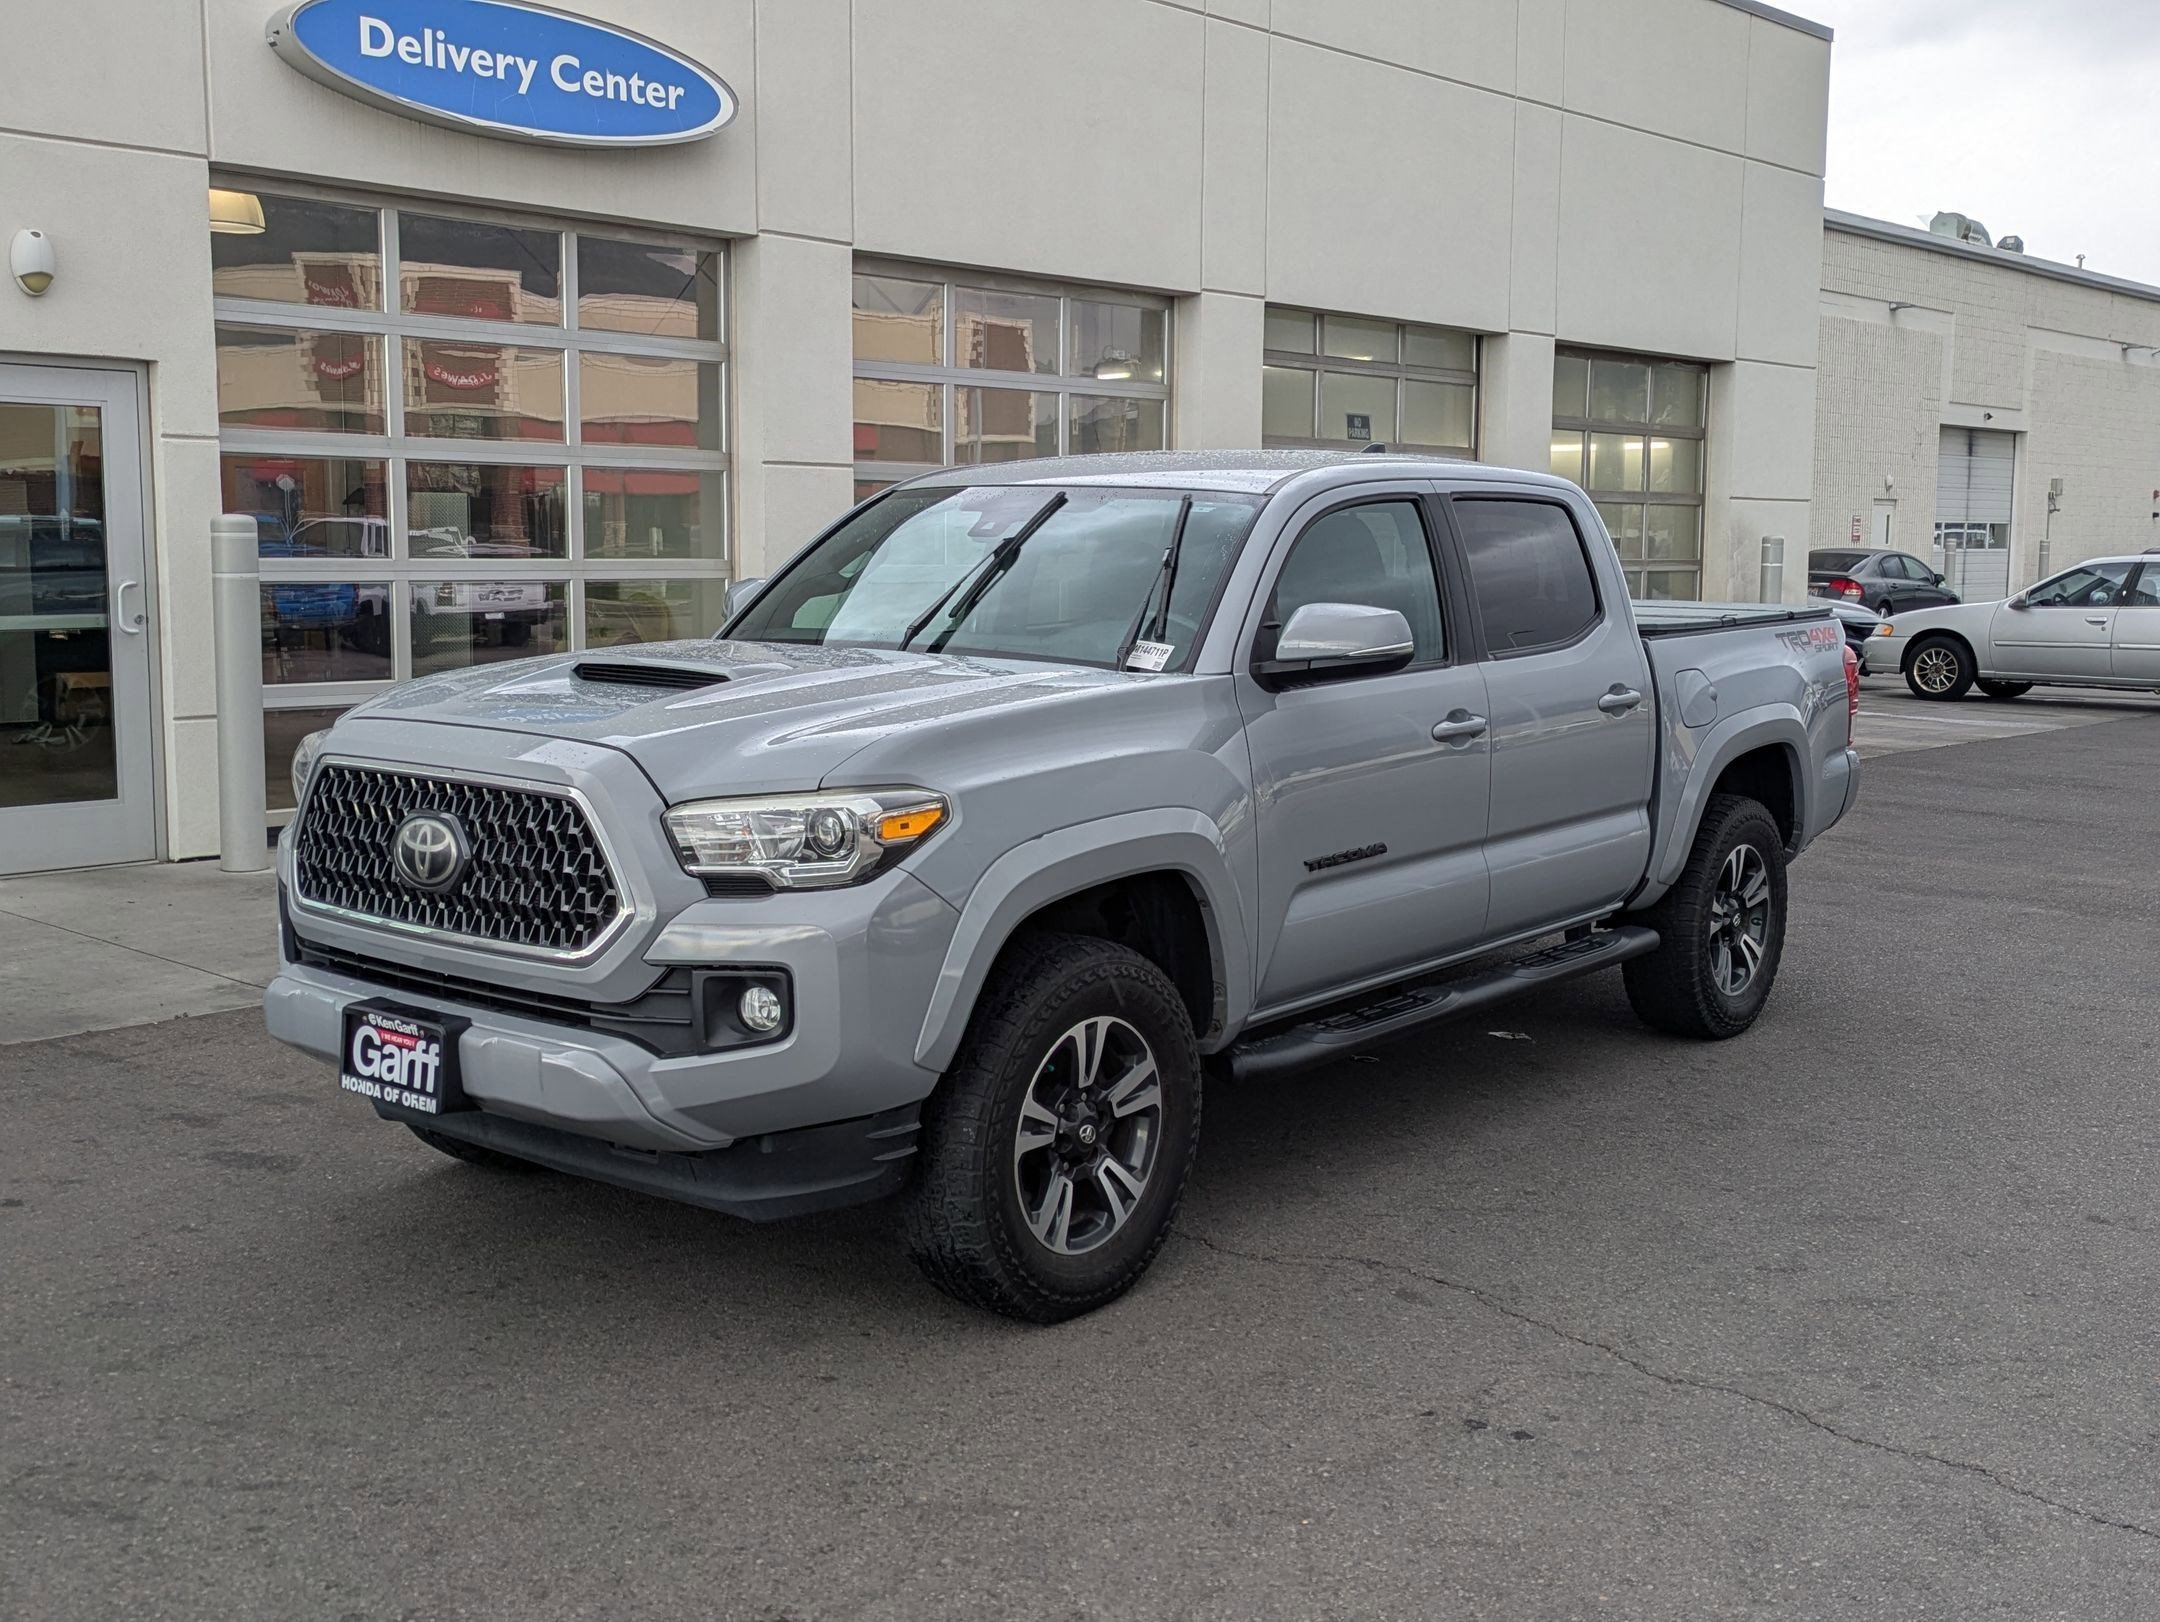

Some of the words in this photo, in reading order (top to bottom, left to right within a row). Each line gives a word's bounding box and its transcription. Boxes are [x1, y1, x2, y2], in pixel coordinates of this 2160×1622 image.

[360, 15, 538, 95] Delivery
[550, 54, 685, 110] Center
[353, 1025, 440, 1093] Garff
[341, 1074, 382, 1099] HONDA
[384, 1087, 400, 1103] OF
[402, 1091, 437, 1114] OREM
